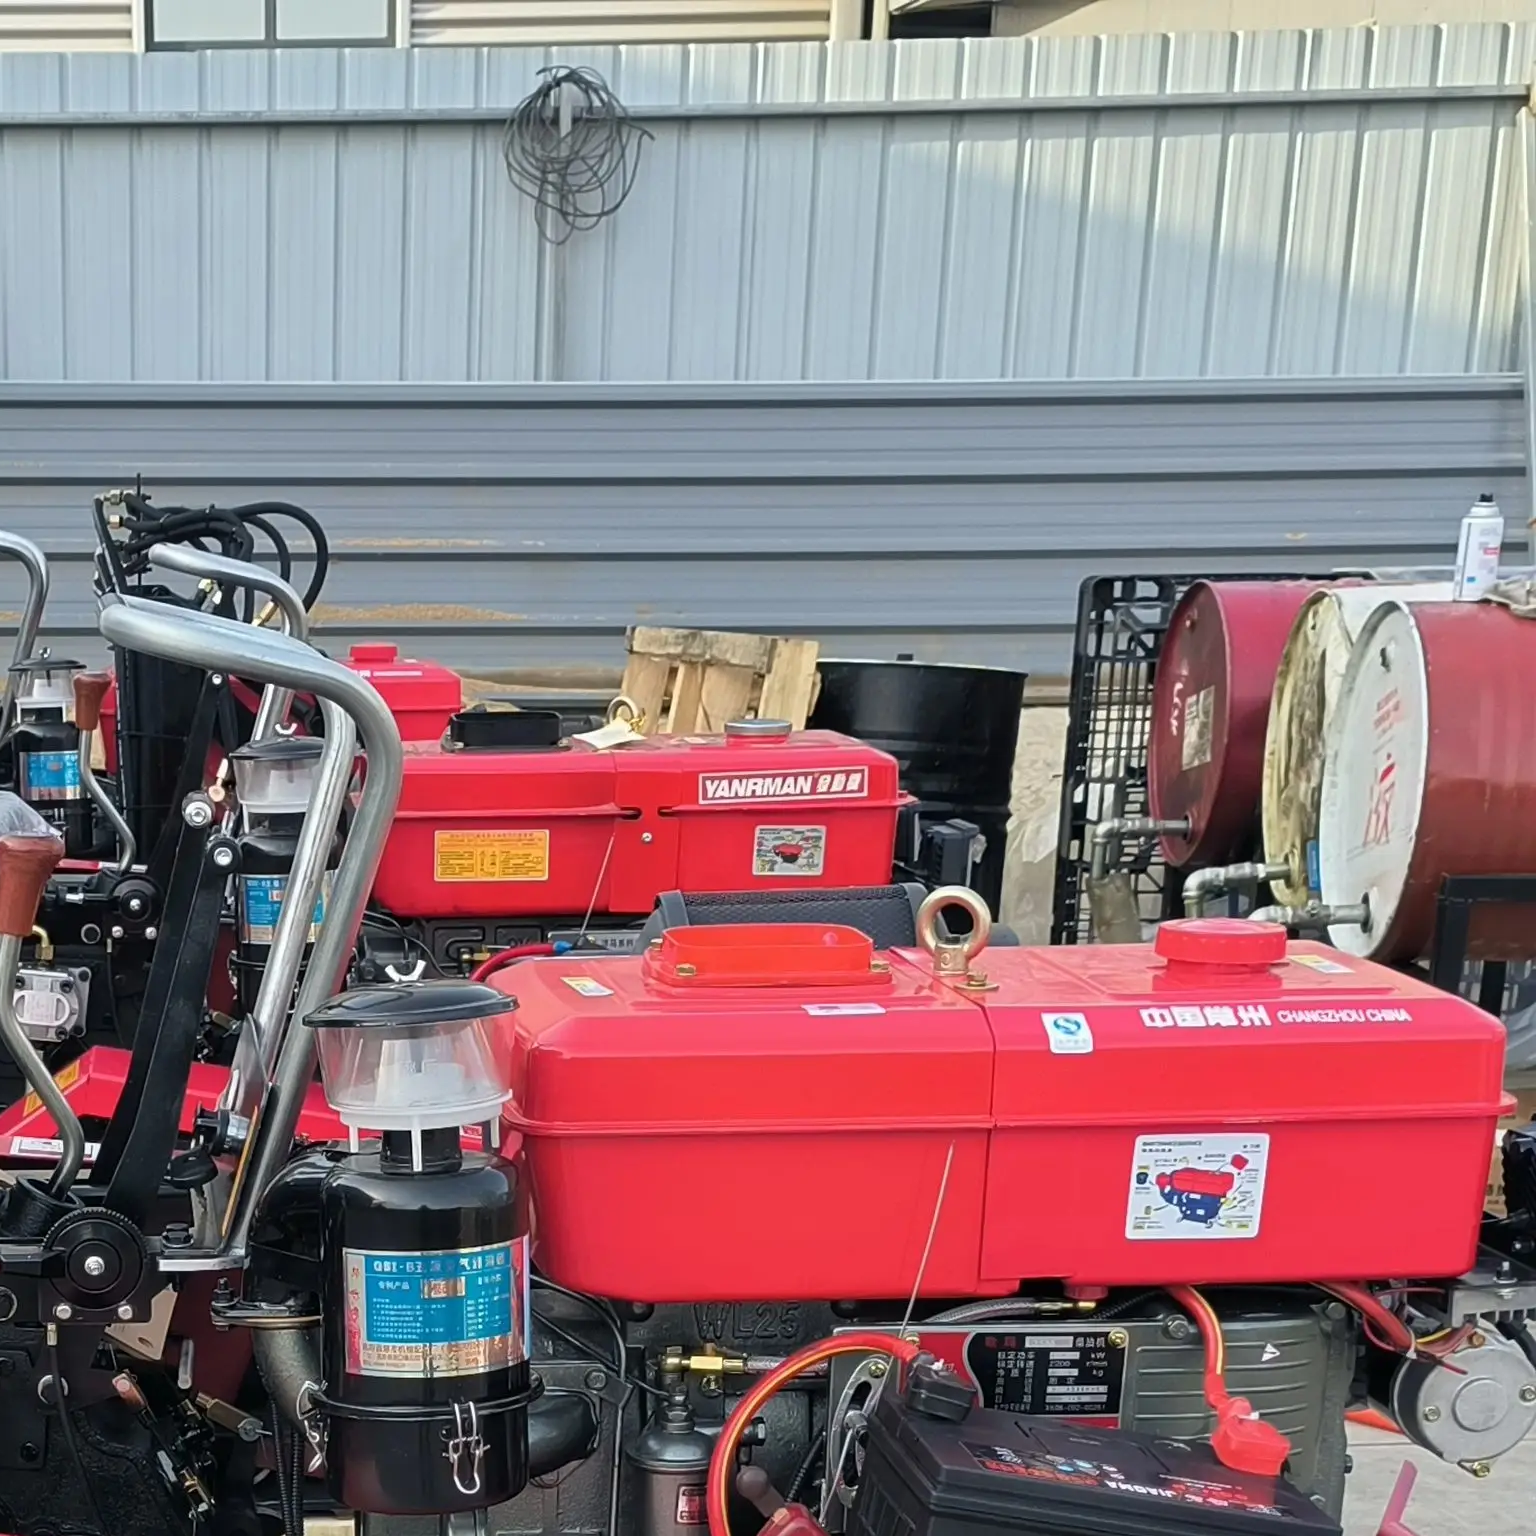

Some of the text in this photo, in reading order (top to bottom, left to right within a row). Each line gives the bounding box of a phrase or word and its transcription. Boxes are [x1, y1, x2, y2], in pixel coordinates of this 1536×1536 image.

[705, 776, 813, 798] YANRMAN
[1139, 1004, 1272, 1028] 中国常州
[1276, 1007, 1413, 1023] CHANGZHOU CHINA
[693, 1301, 801, 1340] WL25
